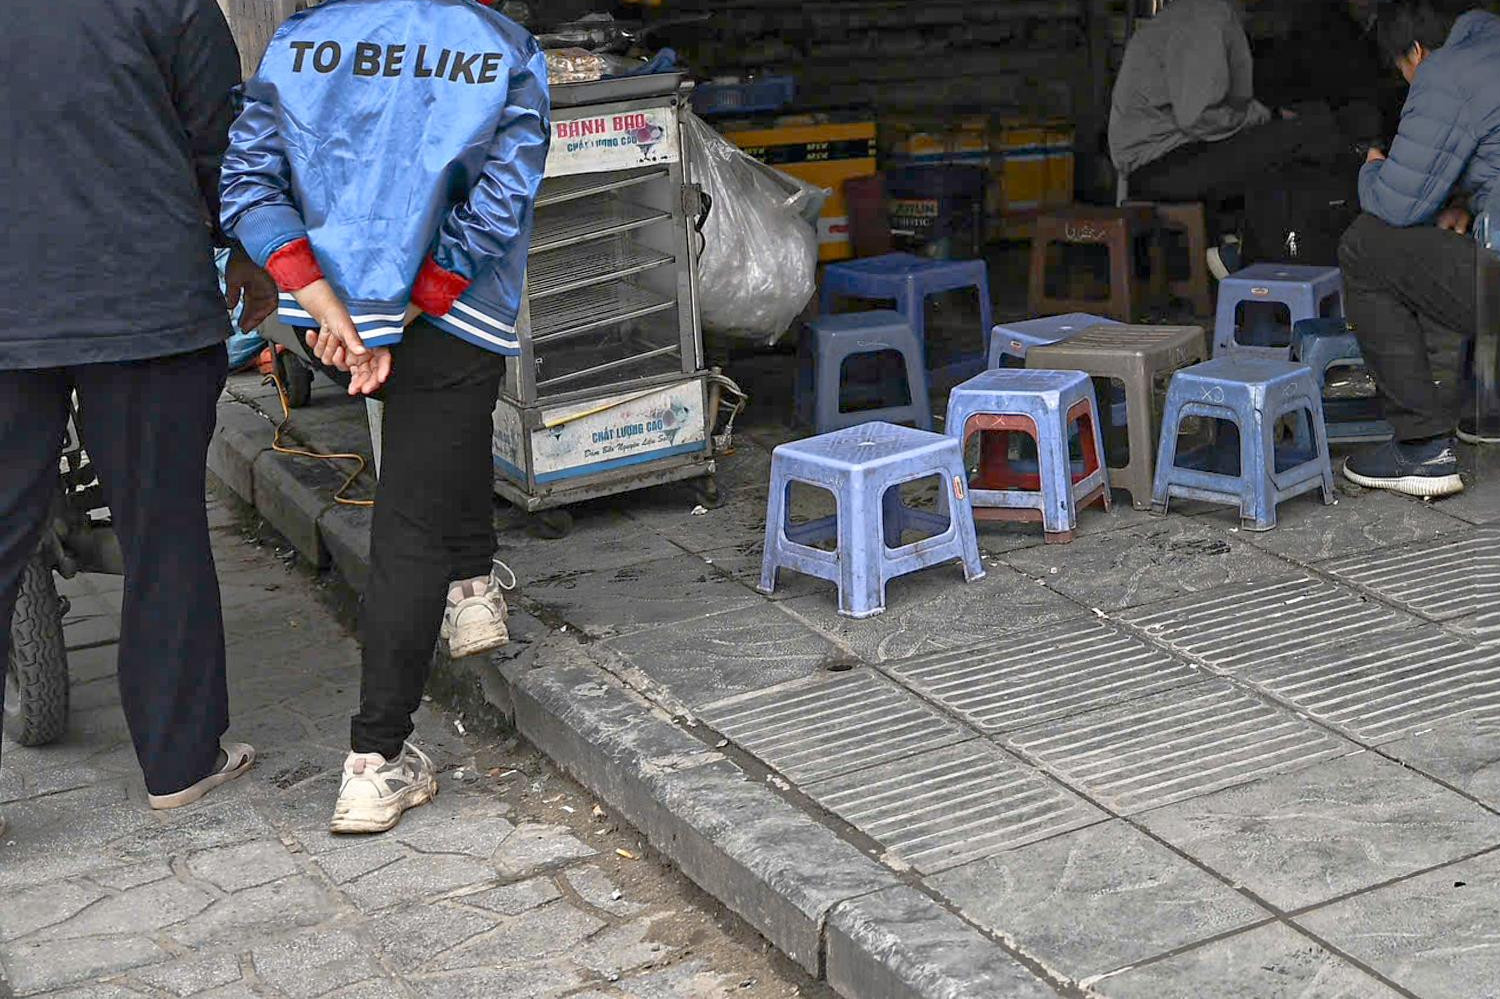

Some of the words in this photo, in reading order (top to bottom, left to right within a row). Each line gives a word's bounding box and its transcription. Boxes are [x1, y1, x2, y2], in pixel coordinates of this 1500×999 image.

[289, 40, 341, 73] TO
[353, 42, 406, 78] BE
[414, 44, 503, 84] LIKE
[612, 113, 645, 131] BAO
[646, 419, 663, 433] CAO
